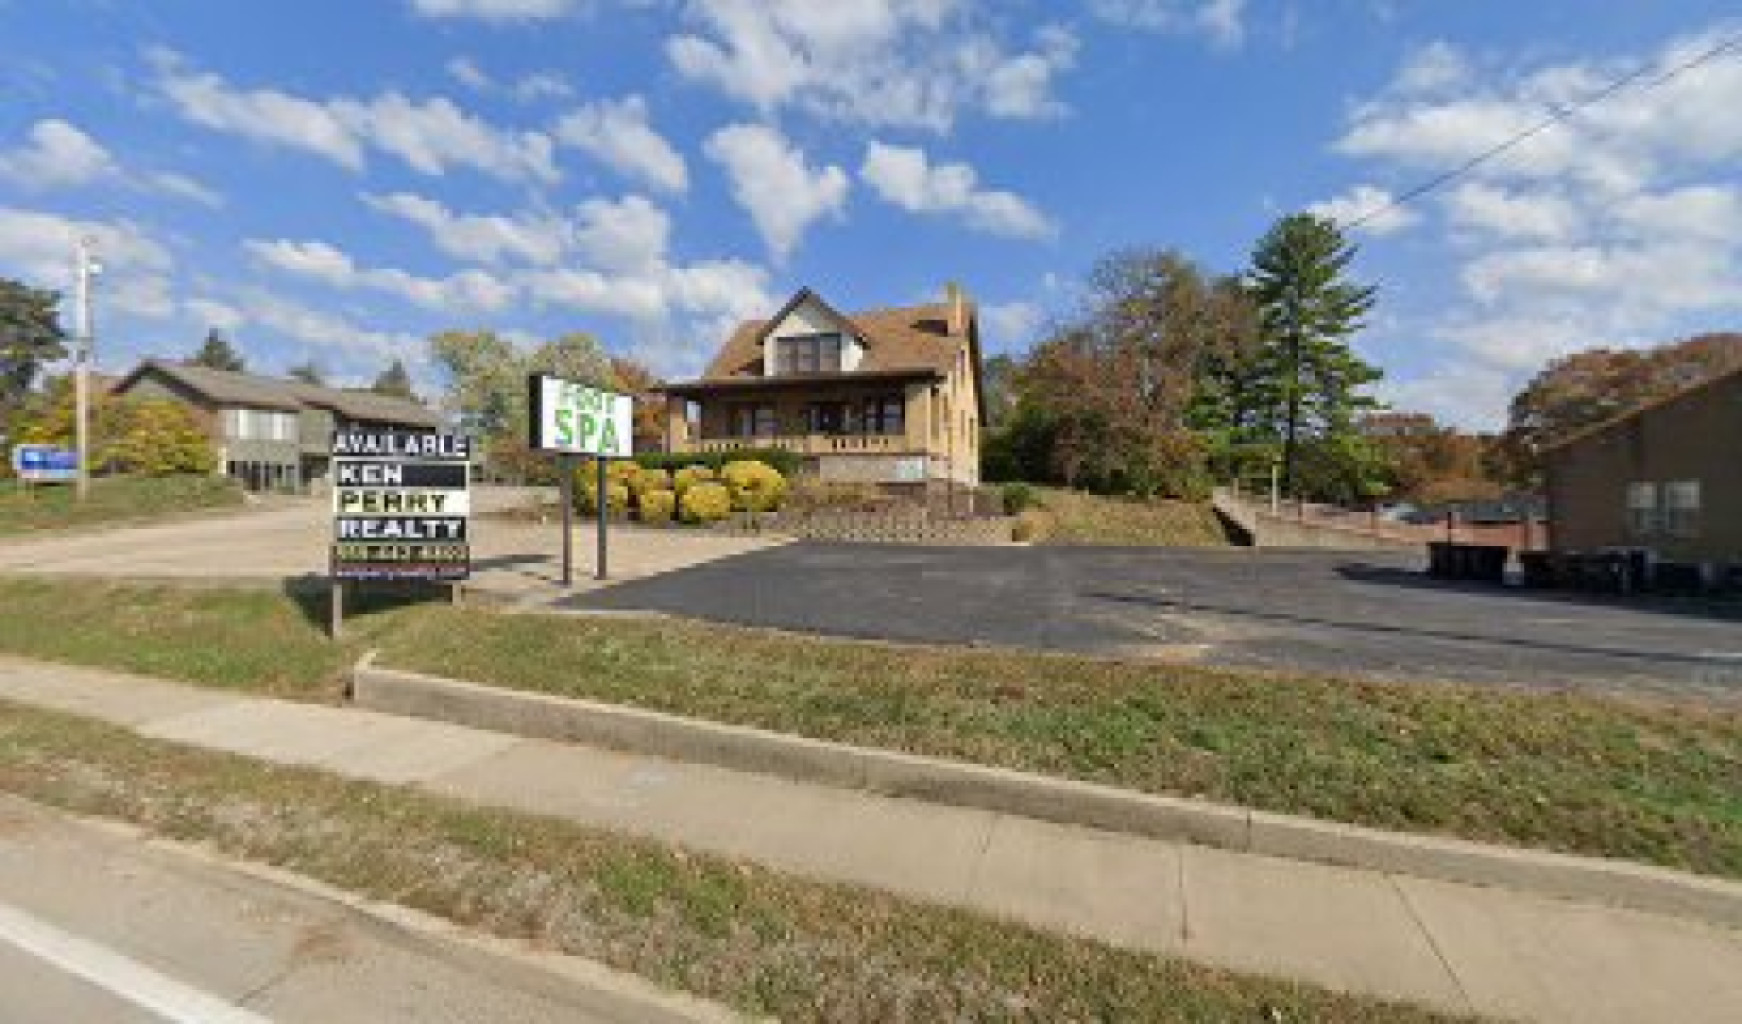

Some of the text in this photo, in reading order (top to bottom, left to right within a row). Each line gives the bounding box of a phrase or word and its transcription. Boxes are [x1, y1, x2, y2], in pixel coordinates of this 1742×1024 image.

[554, 409, 620, 453] SPA
[333, 434, 467, 457] AVAILABLE
[341, 464, 403, 484] KEN
[341, 489, 445, 513] PERRY
[341, 519, 462, 539] REALTY
